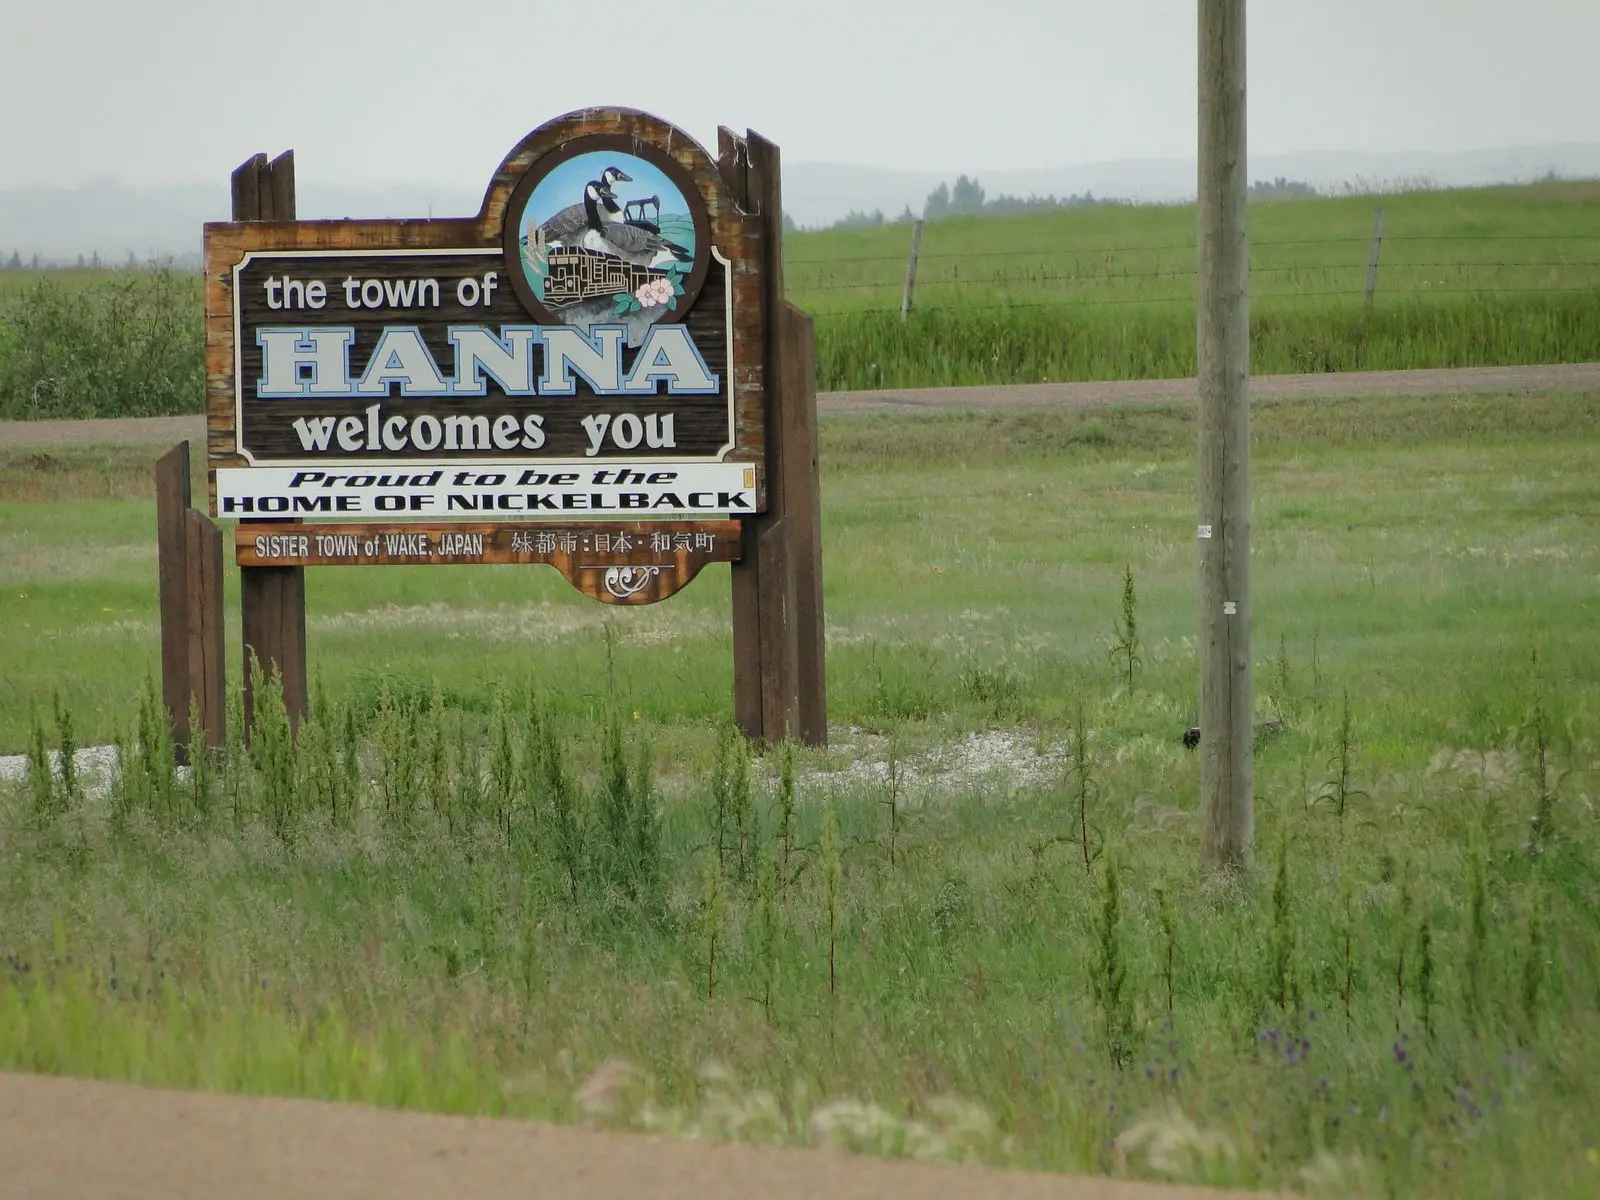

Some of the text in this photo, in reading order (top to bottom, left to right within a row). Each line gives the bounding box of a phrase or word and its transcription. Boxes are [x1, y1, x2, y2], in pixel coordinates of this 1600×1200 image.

[264, 272, 498, 309] the town of
[256, 324, 720, 398] HANNA
[292, 403, 677, 457] welcomes you
[288, 469, 679, 488] Proud to be the
[222, 491, 752, 513] HOME OF NICKELBACK
[255, 534, 309, 558] SISTER
[315, 534, 358, 557] TOWN
[364, 534, 380, 557] of
[438, 533, 483, 556] JAPAN
